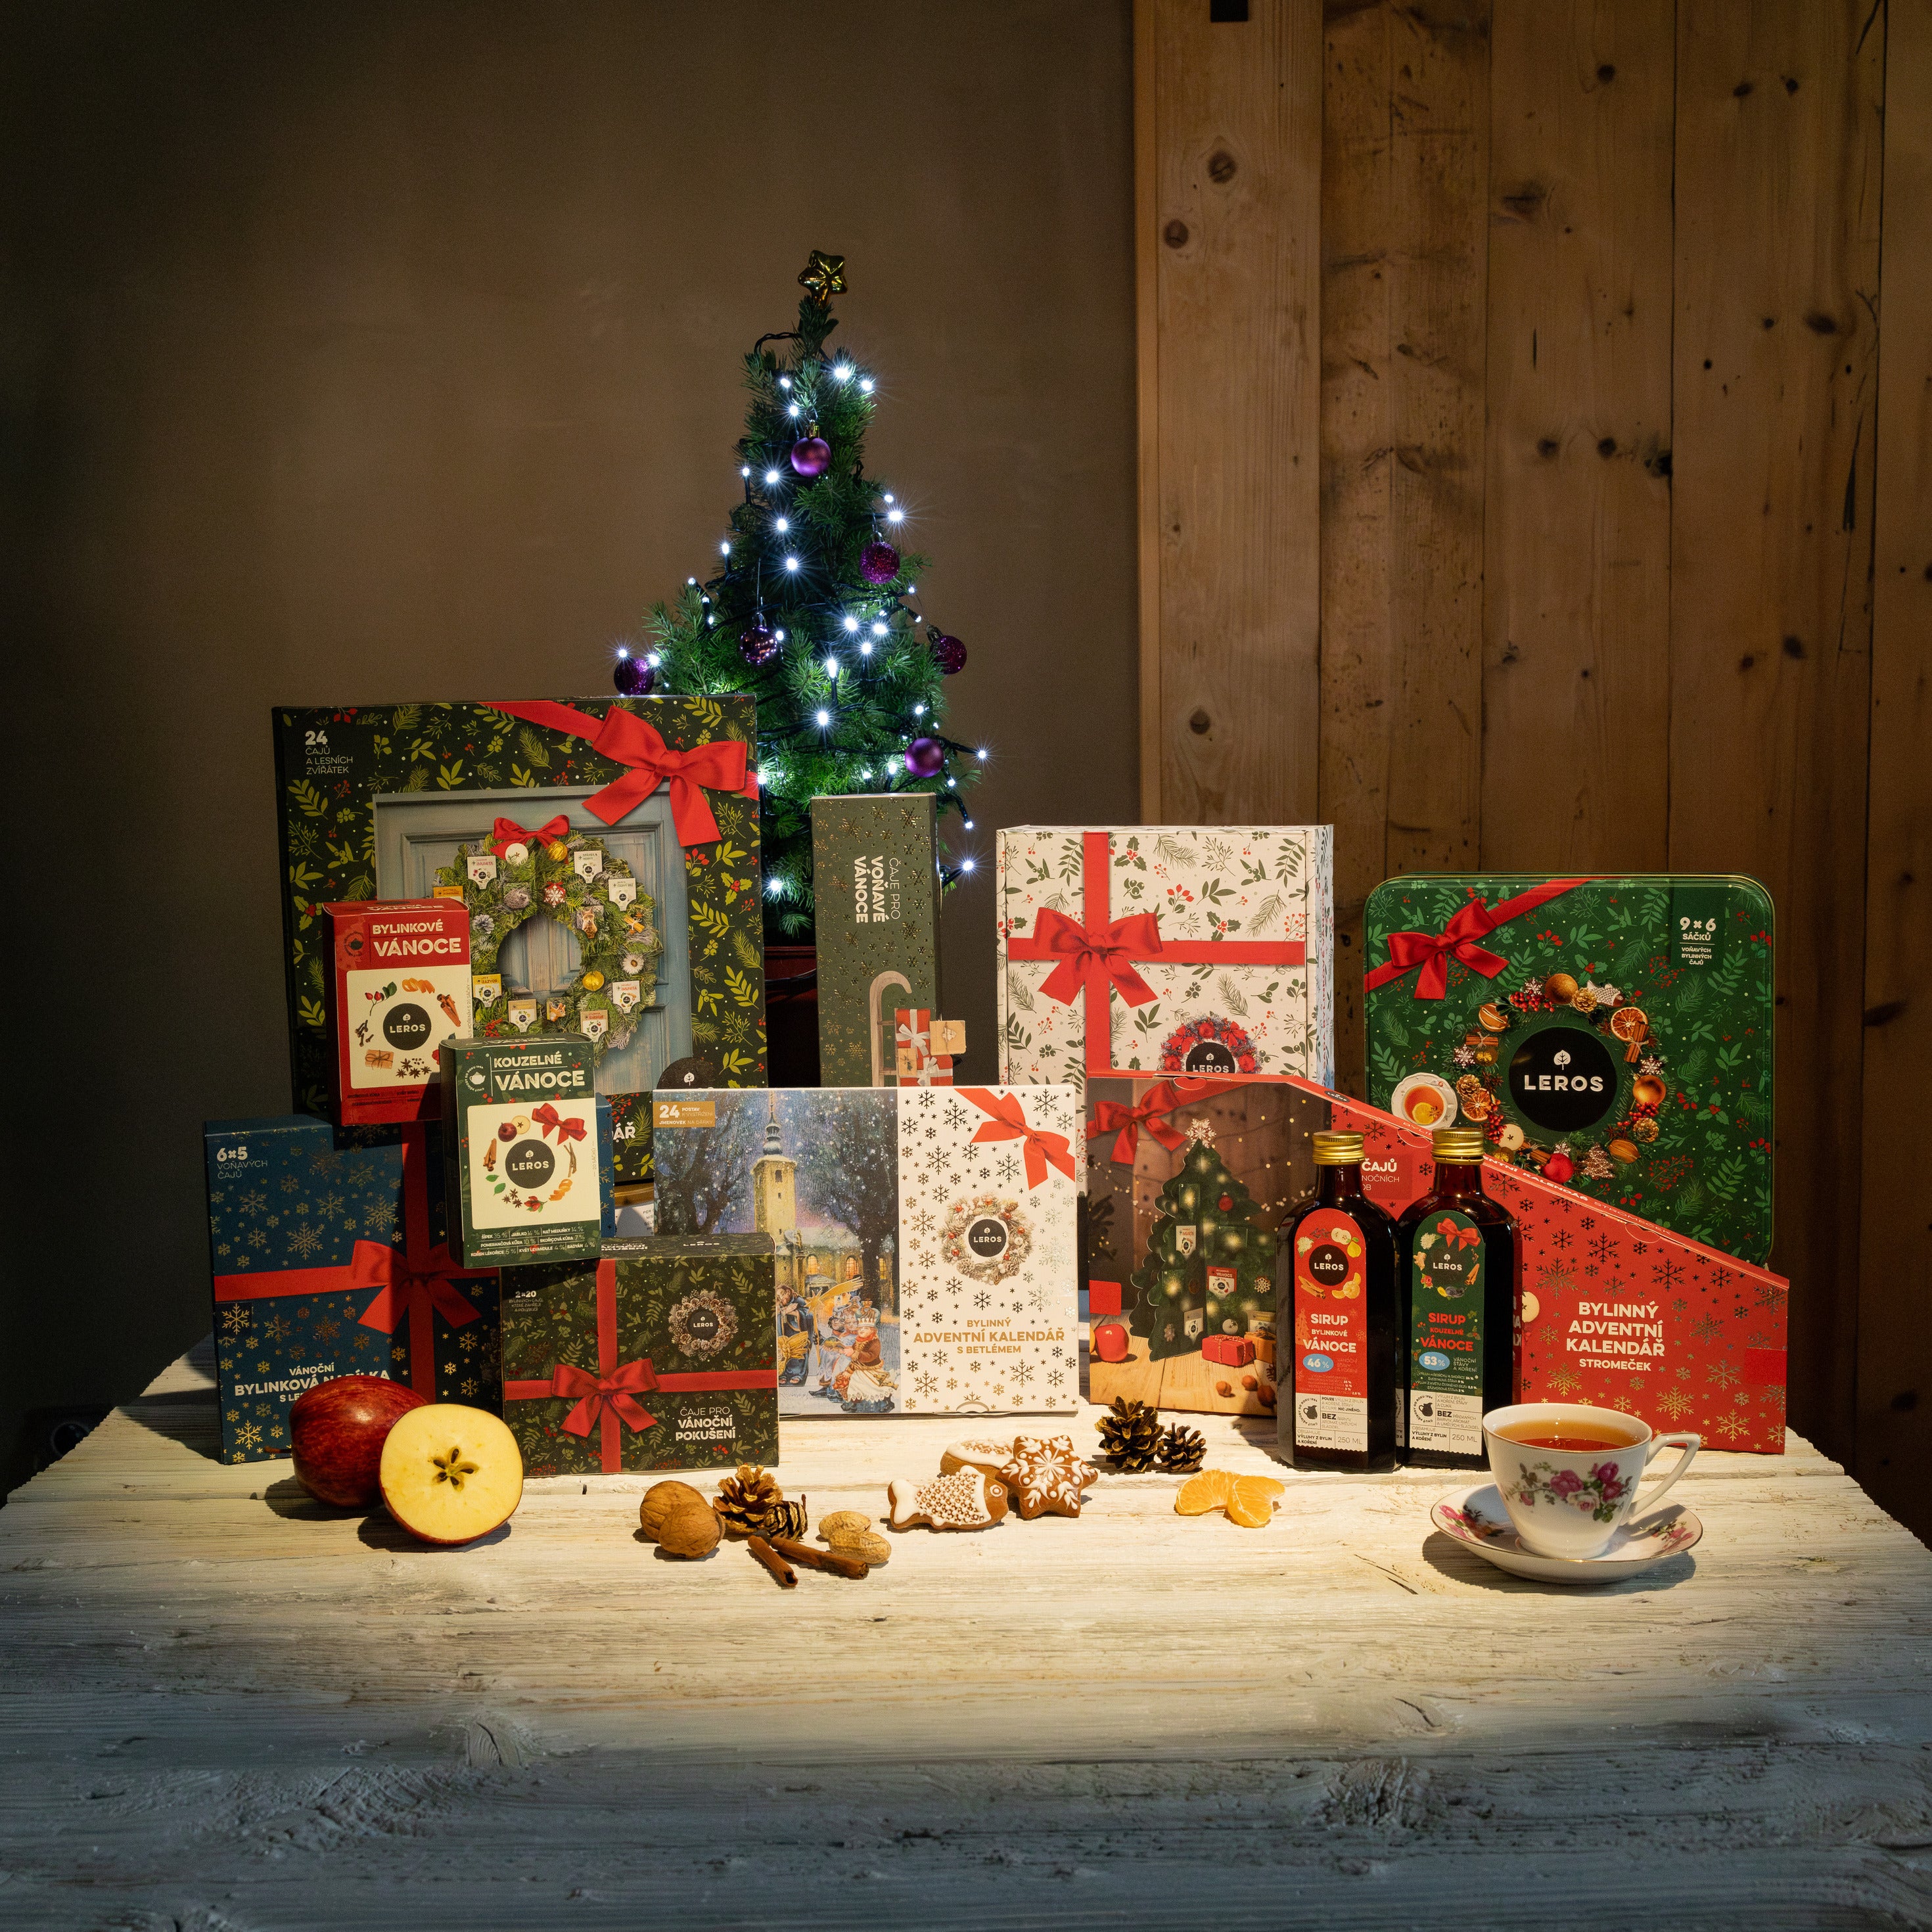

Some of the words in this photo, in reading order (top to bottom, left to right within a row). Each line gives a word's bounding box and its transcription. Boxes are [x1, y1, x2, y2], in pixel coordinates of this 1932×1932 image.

[305, 730, 328, 745] 24
[306, 745, 330, 755] ČAJŮ
[315, 754, 353, 765] LESNÍCH
[306, 765, 349, 775] ZVÍŘÁTEK
[890, 858, 902, 890] ČAJE
[854, 856, 871, 923] VÁNOCE
[871, 856, 890, 923] VOŇAVÉ
[890, 894, 900, 919] PRO
[373, 919, 444, 934] BYLINKOVÉ
[1682, 932, 1711, 941] SÁČKŮ
[373, 938, 461, 957] VÁNOCE
[390, 1024, 426, 1033] LEROS
[494, 1051, 562, 1068] KOUZELNÉ
[1192, 1065, 1230, 1073] LEROS
[495, 1070, 585, 1091] VÁNOCE
[1525, 1075, 1603, 1092] LEROS
[660, 1104, 680, 1118] 24
[217, 1159, 268, 1170] VOŇAVÝCH
[512, 1161, 549, 1171] LEROS
[1362, 1158, 1397, 1172] ČAJŮ
[218, 1169, 242, 1179] ČAJŮ
[1362, 1174, 1400, 1183] NOČNÍCH
[1483, 1155, 1519, 1172] ENTNÍ
[1523, 1172, 1588, 1201] KALENDÁŘ
[1594, 1201, 1671, 1235] STROMEČEK
[1433, 1262, 1463, 1271] LEROS
[1578, 1300, 1659, 1319] BYLINNÝ
[967, 1318, 1011, 1328] BYLINNÝ
[1310, 1313, 1348, 1325] SIRUP
[1429, 1312, 1466, 1325] SIRUP
[913, 1329, 986, 1343] ADVENTNÍ
[990, 1327, 1065, 1342] KALENDÁŘ
[1568, 1320, 1663, 1338] ADVENTNÍ
[966, 1345, 1021, 1354] BETLÉMEM
[1302, 1337, 1356, 1353] VÁNOCE
[1421, 1334, 1474, 1352] VÁNOCE
[1566, 1337, 1665, 1357] KALENDÁŘ
[289, 1362, 334, 1376] VÁNOČNÍ
[1579, 1357, 1651, 1371] STROMEČEK
[234, 1373, 319, 1396] BYLINKOVÁ
[680, 1406, 706, 1416] ČAJE
[710, 1406, 730, 1415] PRO
[678, 1414, 733, 1429] VÁNOČNÍ
[676, 1426, 736, 1441] POKUŠENÍ
